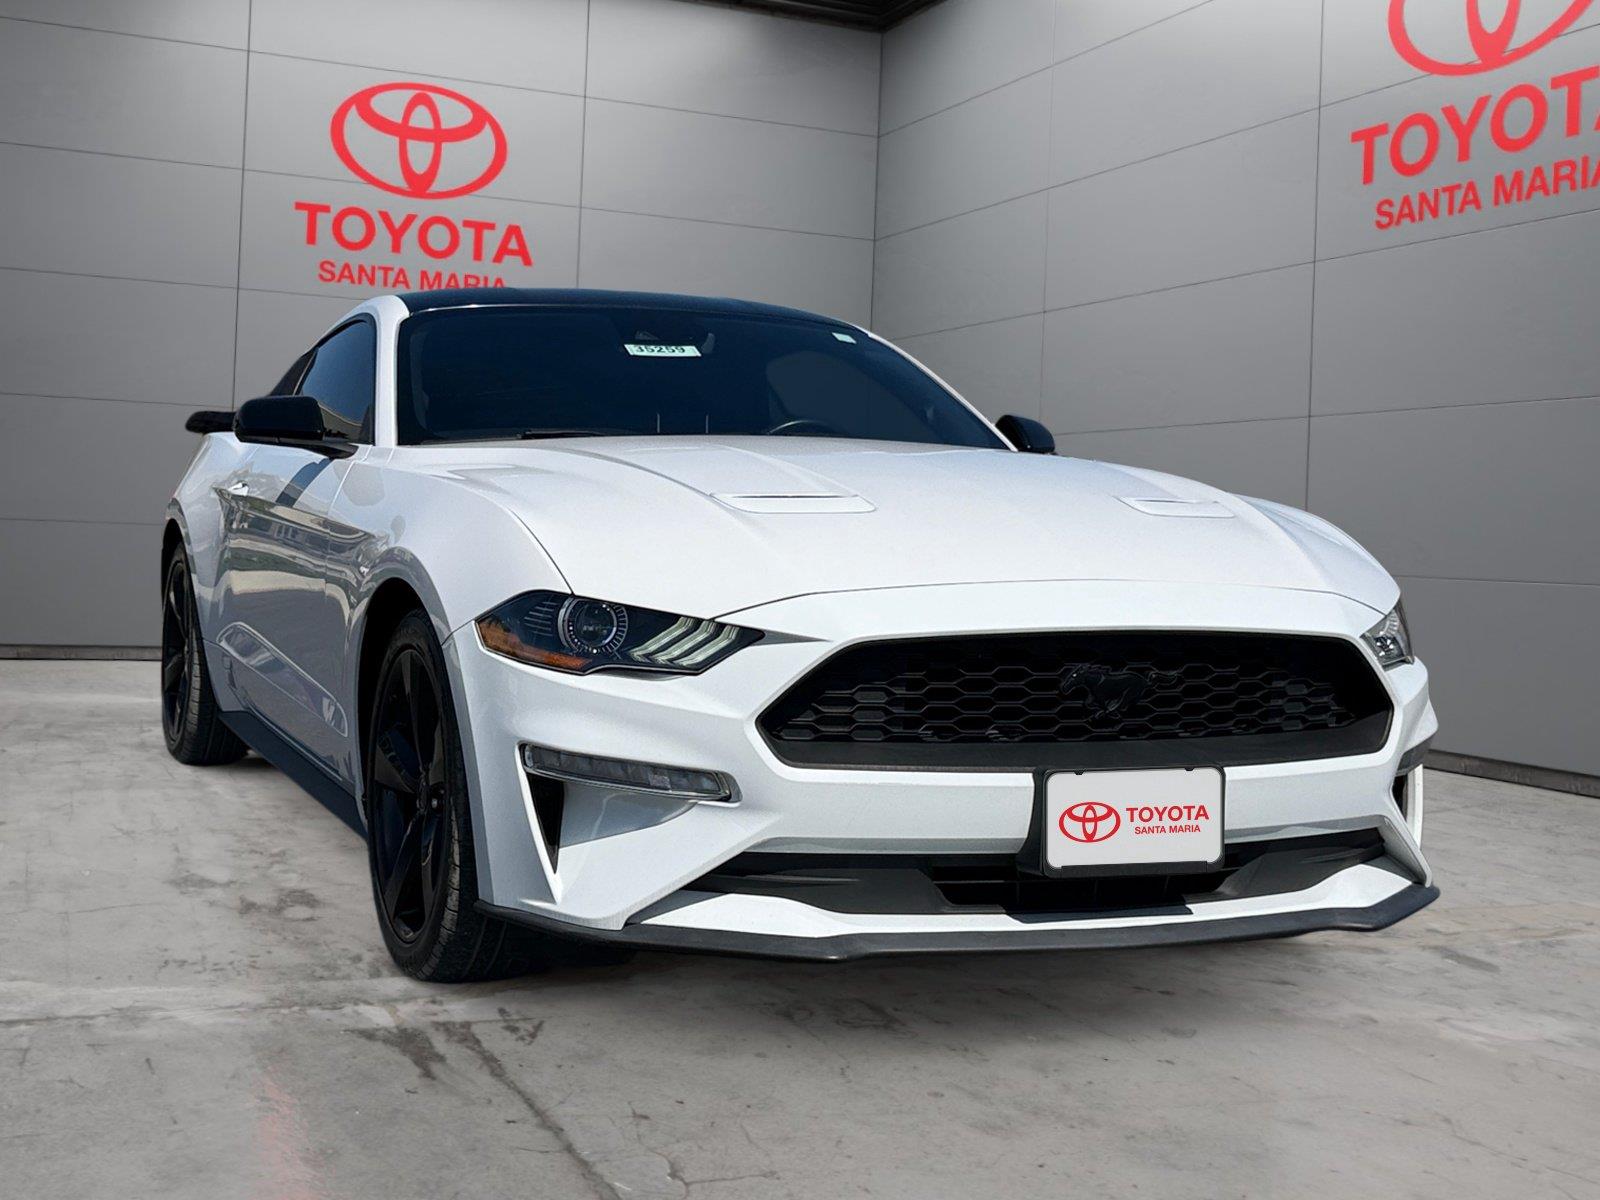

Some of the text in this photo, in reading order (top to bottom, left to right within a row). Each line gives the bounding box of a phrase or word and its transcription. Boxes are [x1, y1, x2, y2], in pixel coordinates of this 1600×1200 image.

[1350, 65, 1600, 186] TOYOT
[1375, 179, 1482, 230] SANTA
[293, 201, 534, 268] TOYOTA
[318, 259, 411, 290] SANTA
[1126, 805, 1209, 823] TOYOTA
[1135, 824, 1201, 835] SANTA MARIA
